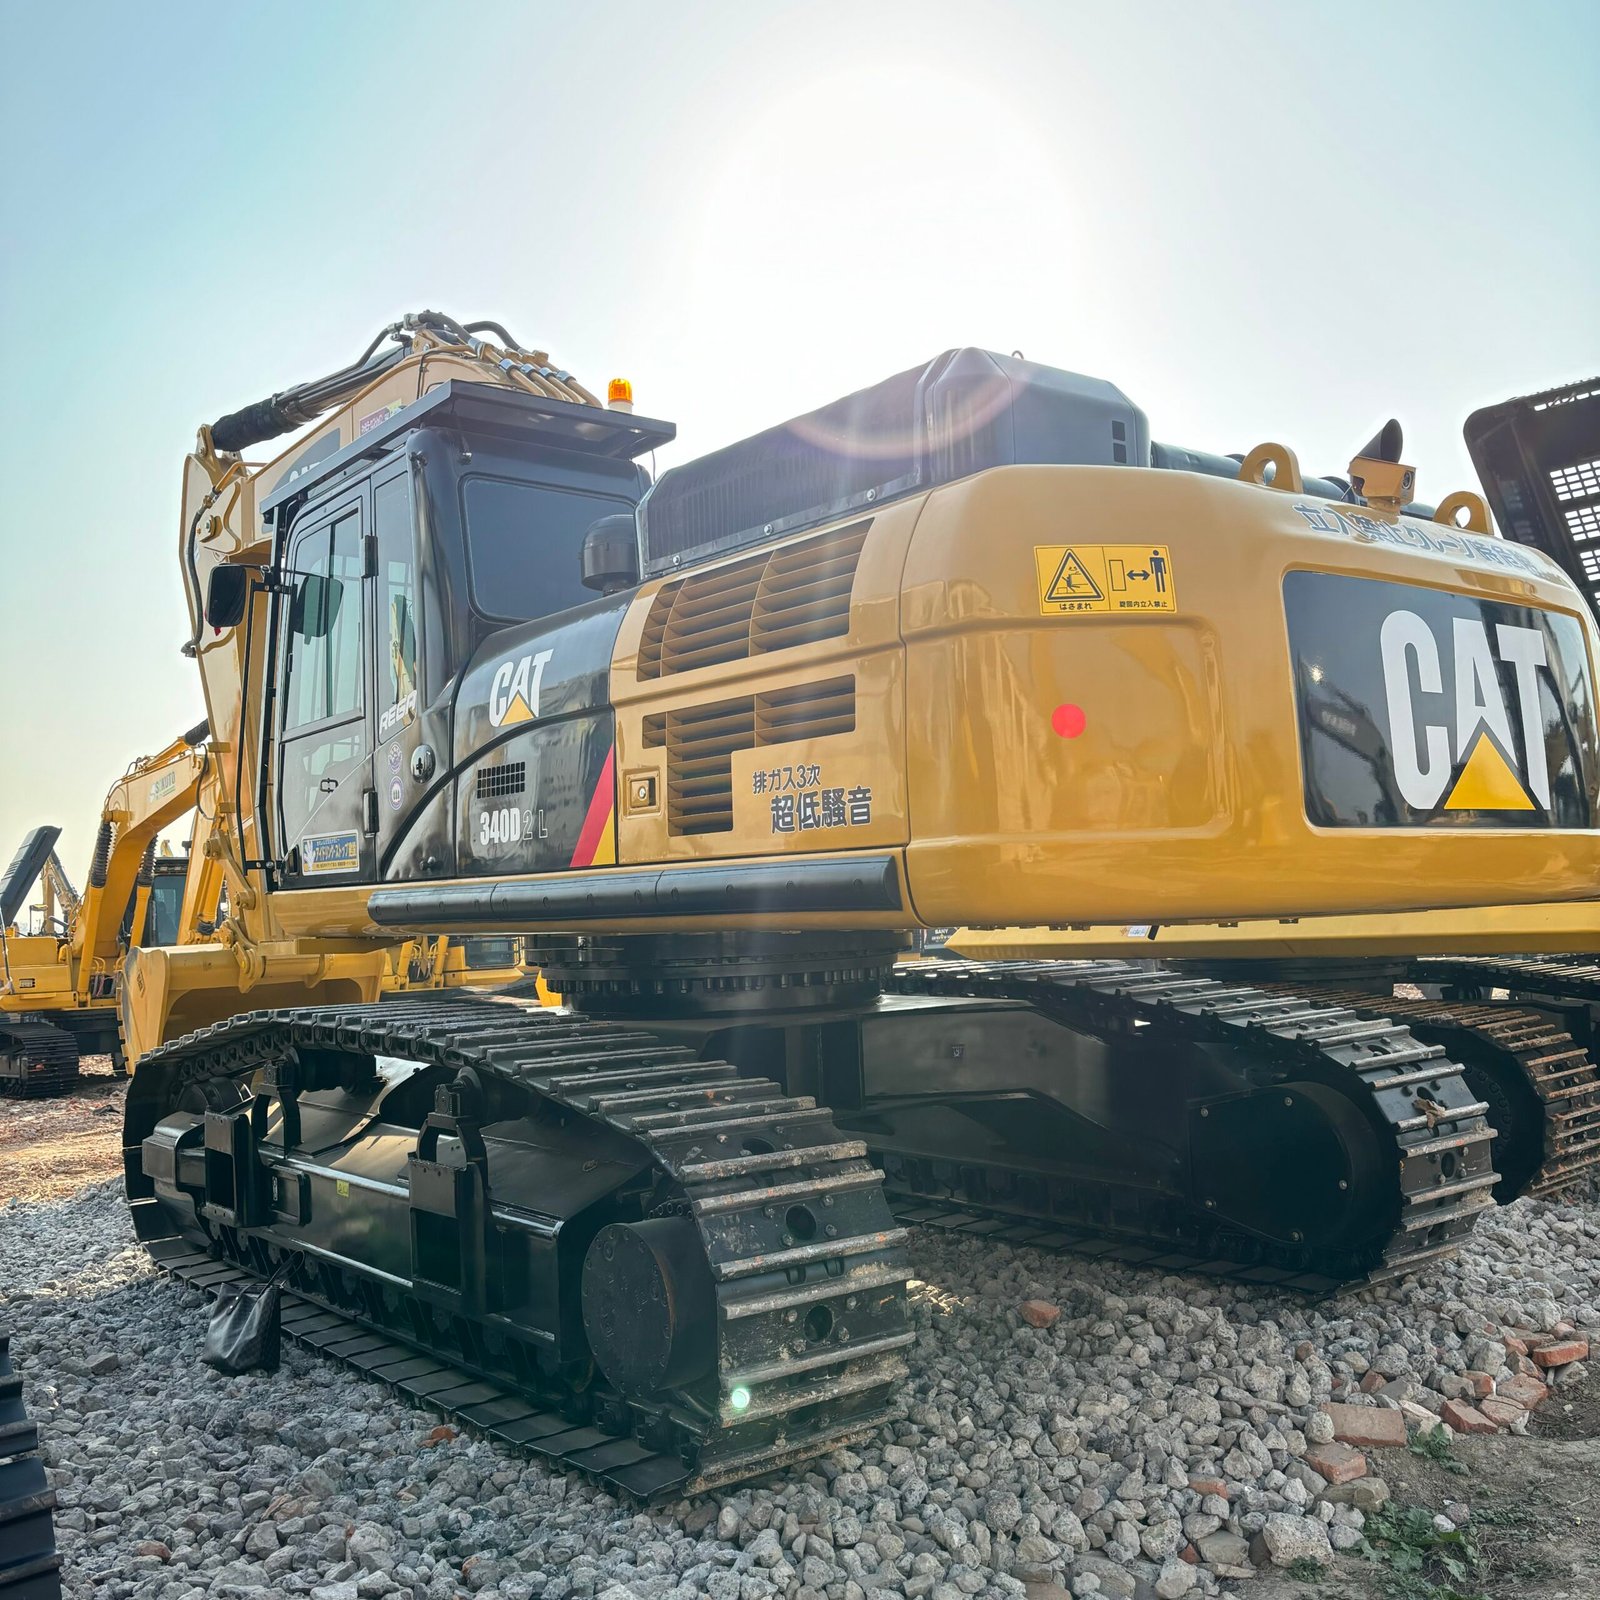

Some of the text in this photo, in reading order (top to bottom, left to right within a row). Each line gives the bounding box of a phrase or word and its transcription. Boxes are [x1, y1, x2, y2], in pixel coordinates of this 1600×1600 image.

[1059, 602, 1092, 611] はさまれ
[489, 648, 554, 727] CAT
[1380, 610, 1551, 810] CAT
[752, 764, 821, 795] 排ガス3次
[770, 785, 873, 834] 超低騒音
